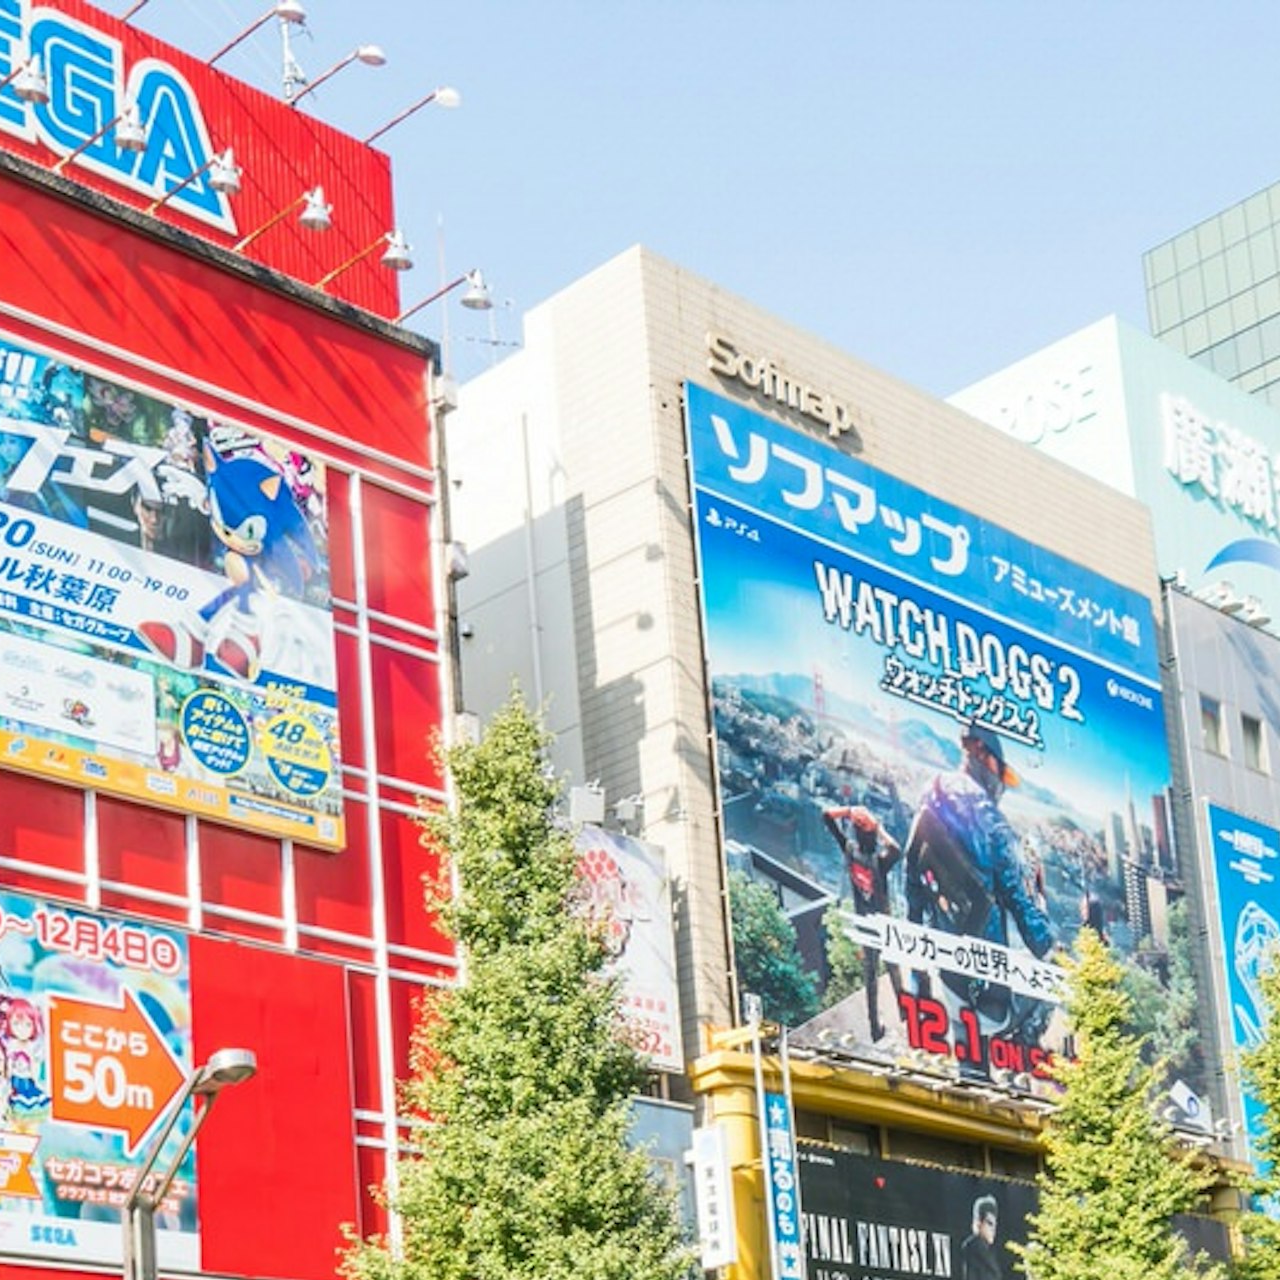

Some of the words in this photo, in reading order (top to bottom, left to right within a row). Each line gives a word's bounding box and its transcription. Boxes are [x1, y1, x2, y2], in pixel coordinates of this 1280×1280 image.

[706, 331, 851, 437] Sofmap
[710, 414, 970, 576] ソフマップ
[270, 720, 306, 744] 48
[60, 1020, 149, 1058] ここから
[898, 991, 982, 1064] 12.1
[989, 1036, 1025, 1073] ON
[31, 1224, 78, 1247] SEGA
[931, 1232, 952, 1278] XV
